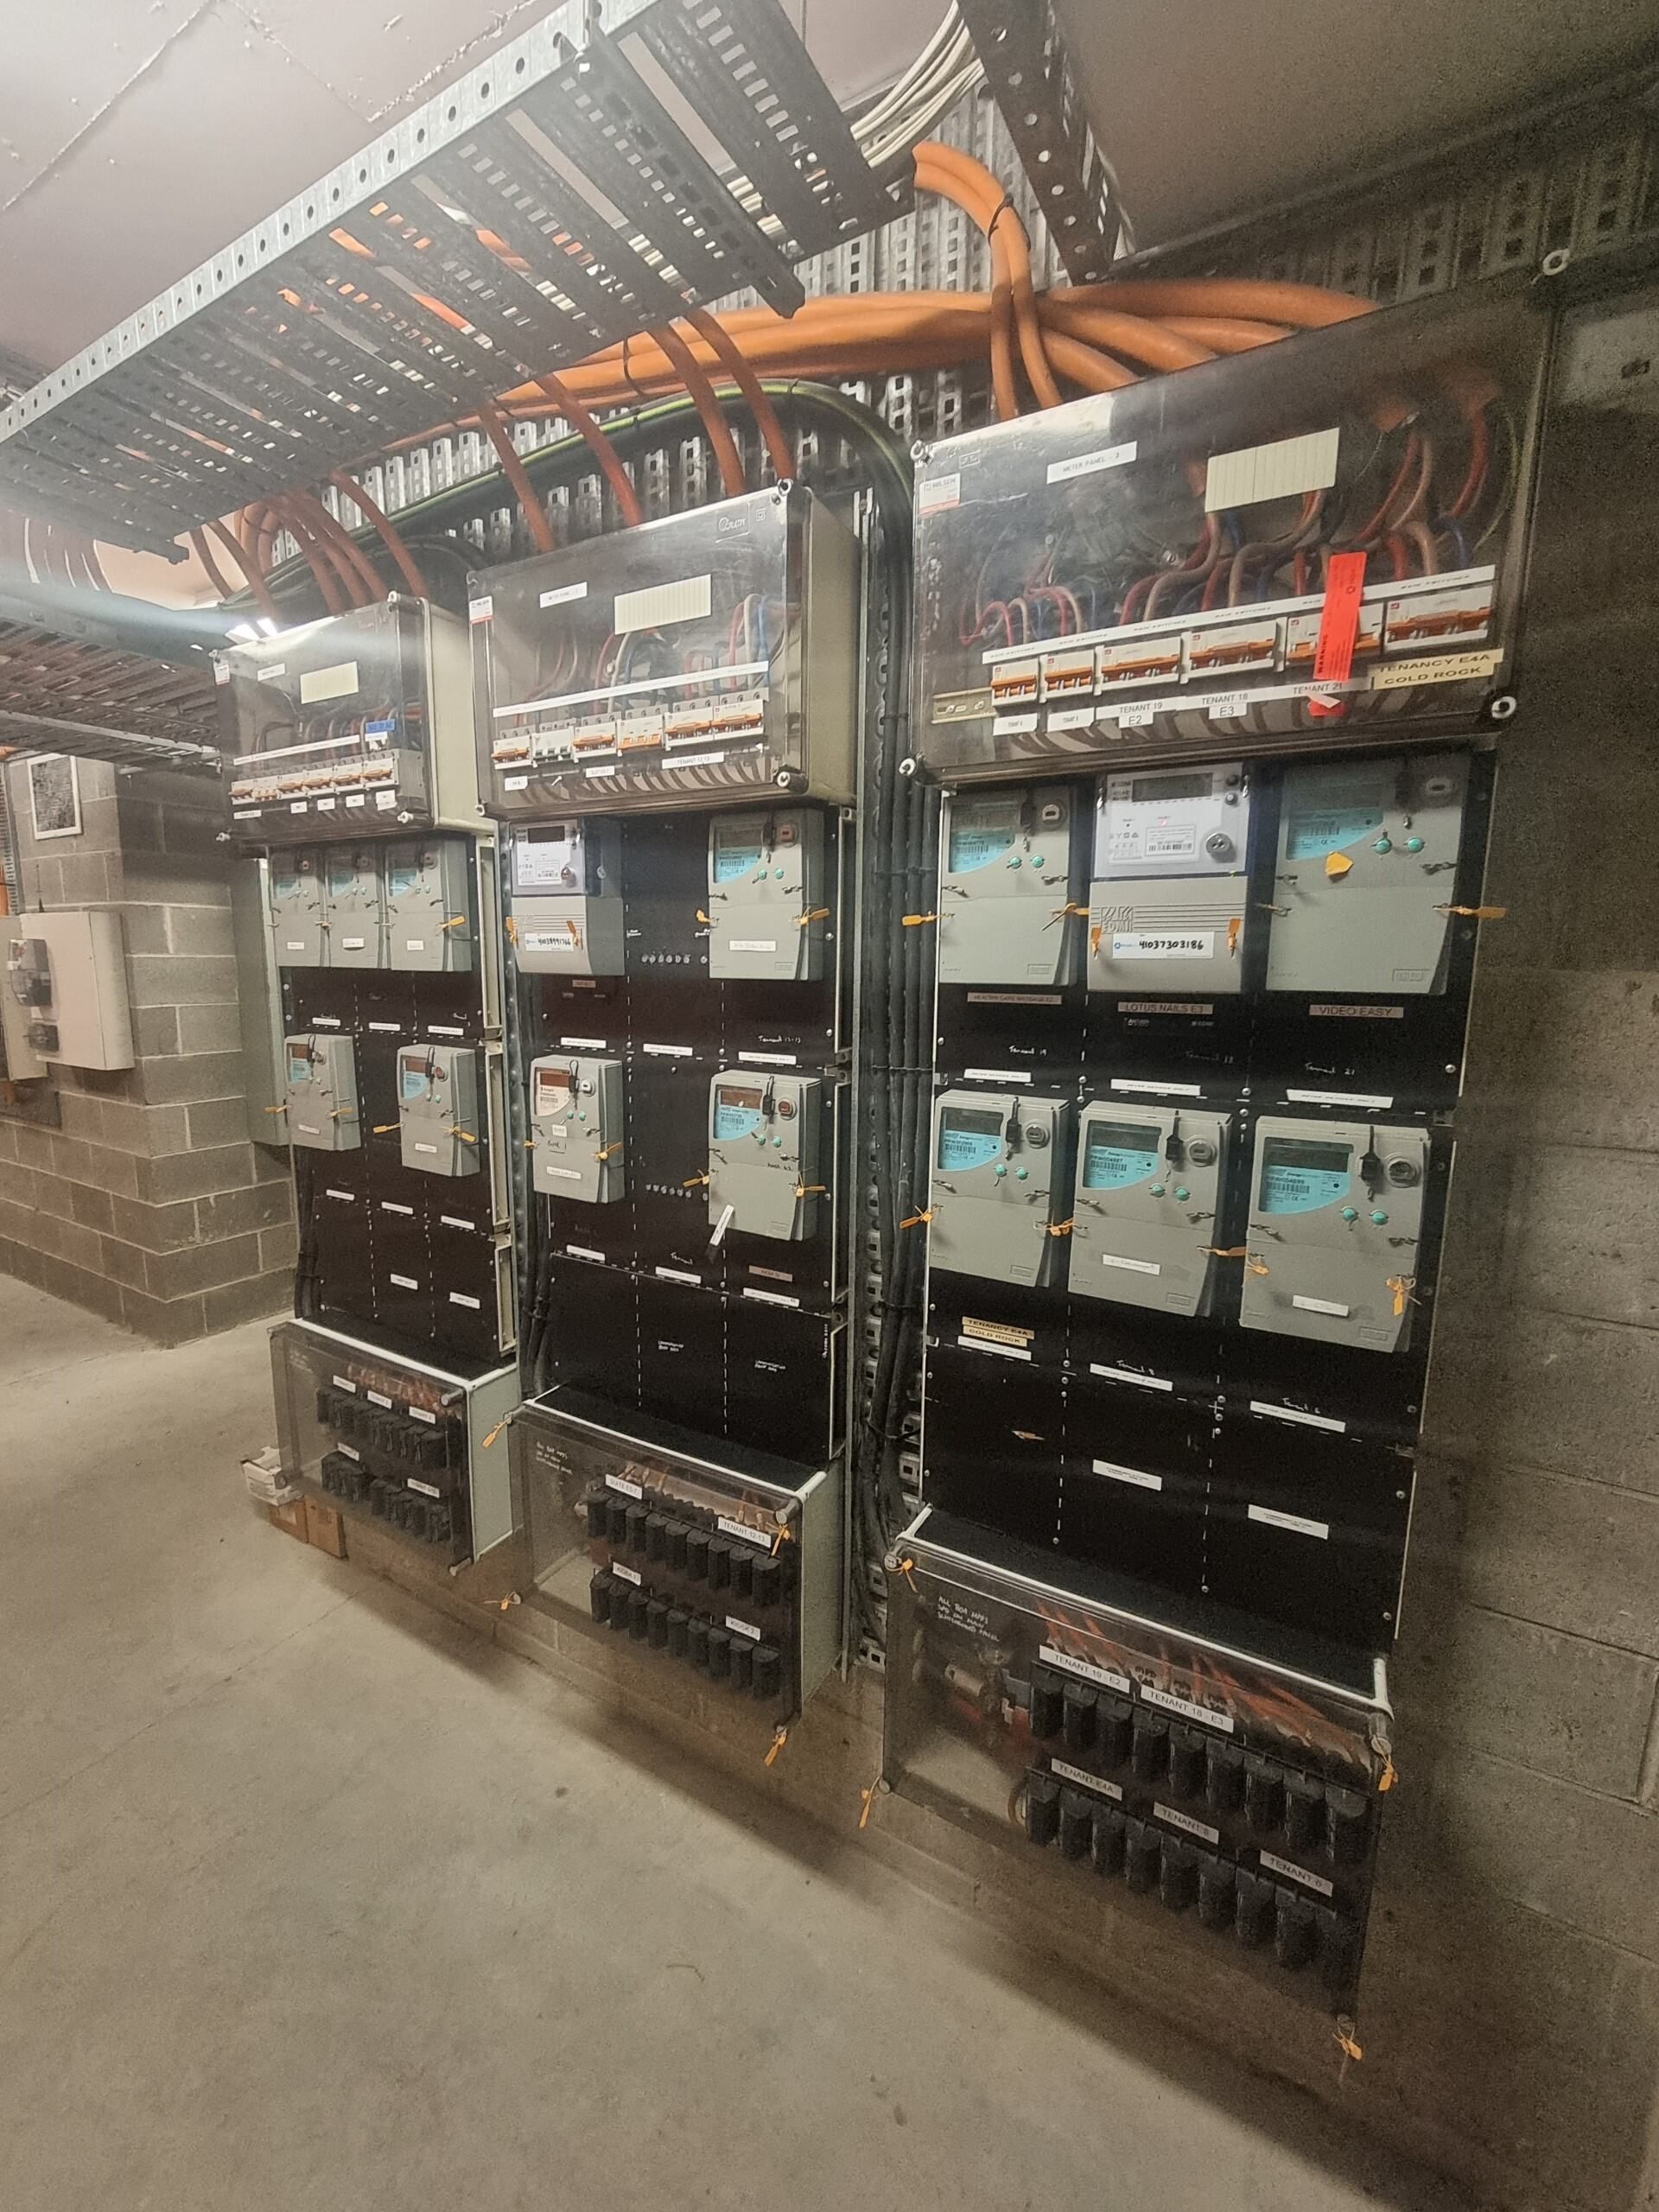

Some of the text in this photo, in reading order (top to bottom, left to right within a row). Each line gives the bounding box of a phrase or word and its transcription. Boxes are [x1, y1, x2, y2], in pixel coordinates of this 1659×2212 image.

[1379, 658, 1454, 672] TENANCY
[1433, 666, 1481, 678] ROCK
[1201, 694, 1236, 705] TENANT
[1119, 702, 1162, 714] TENANT 19
[1219, 706, 1235, 716] E3
[1128, 715, 1142, 726] E2
[1126, 1003, 1203, 1014] LOTUS NAILS E3
[1319, 1007, 1394, 1017] VIDEO EASY
[968, 1319, 1009, 1332] TENANCY
[995, 1334, 1020, 1344] ROCK
[1054, 1654, 1089, 1676] TENANT
[1092, 1669, 1103, 1679] 19
[1109, 1675, 1121, 1686] E2
[1149, 1690, 1188, 1713] TENANT
[1211, 1713, 1224, 1726] E3
[1059, 1764, 1095, 1785] TENANT
[1162, 1808, 1199, 1833] TENANT
[1270, 1857, 1311, 1882] TENANT
